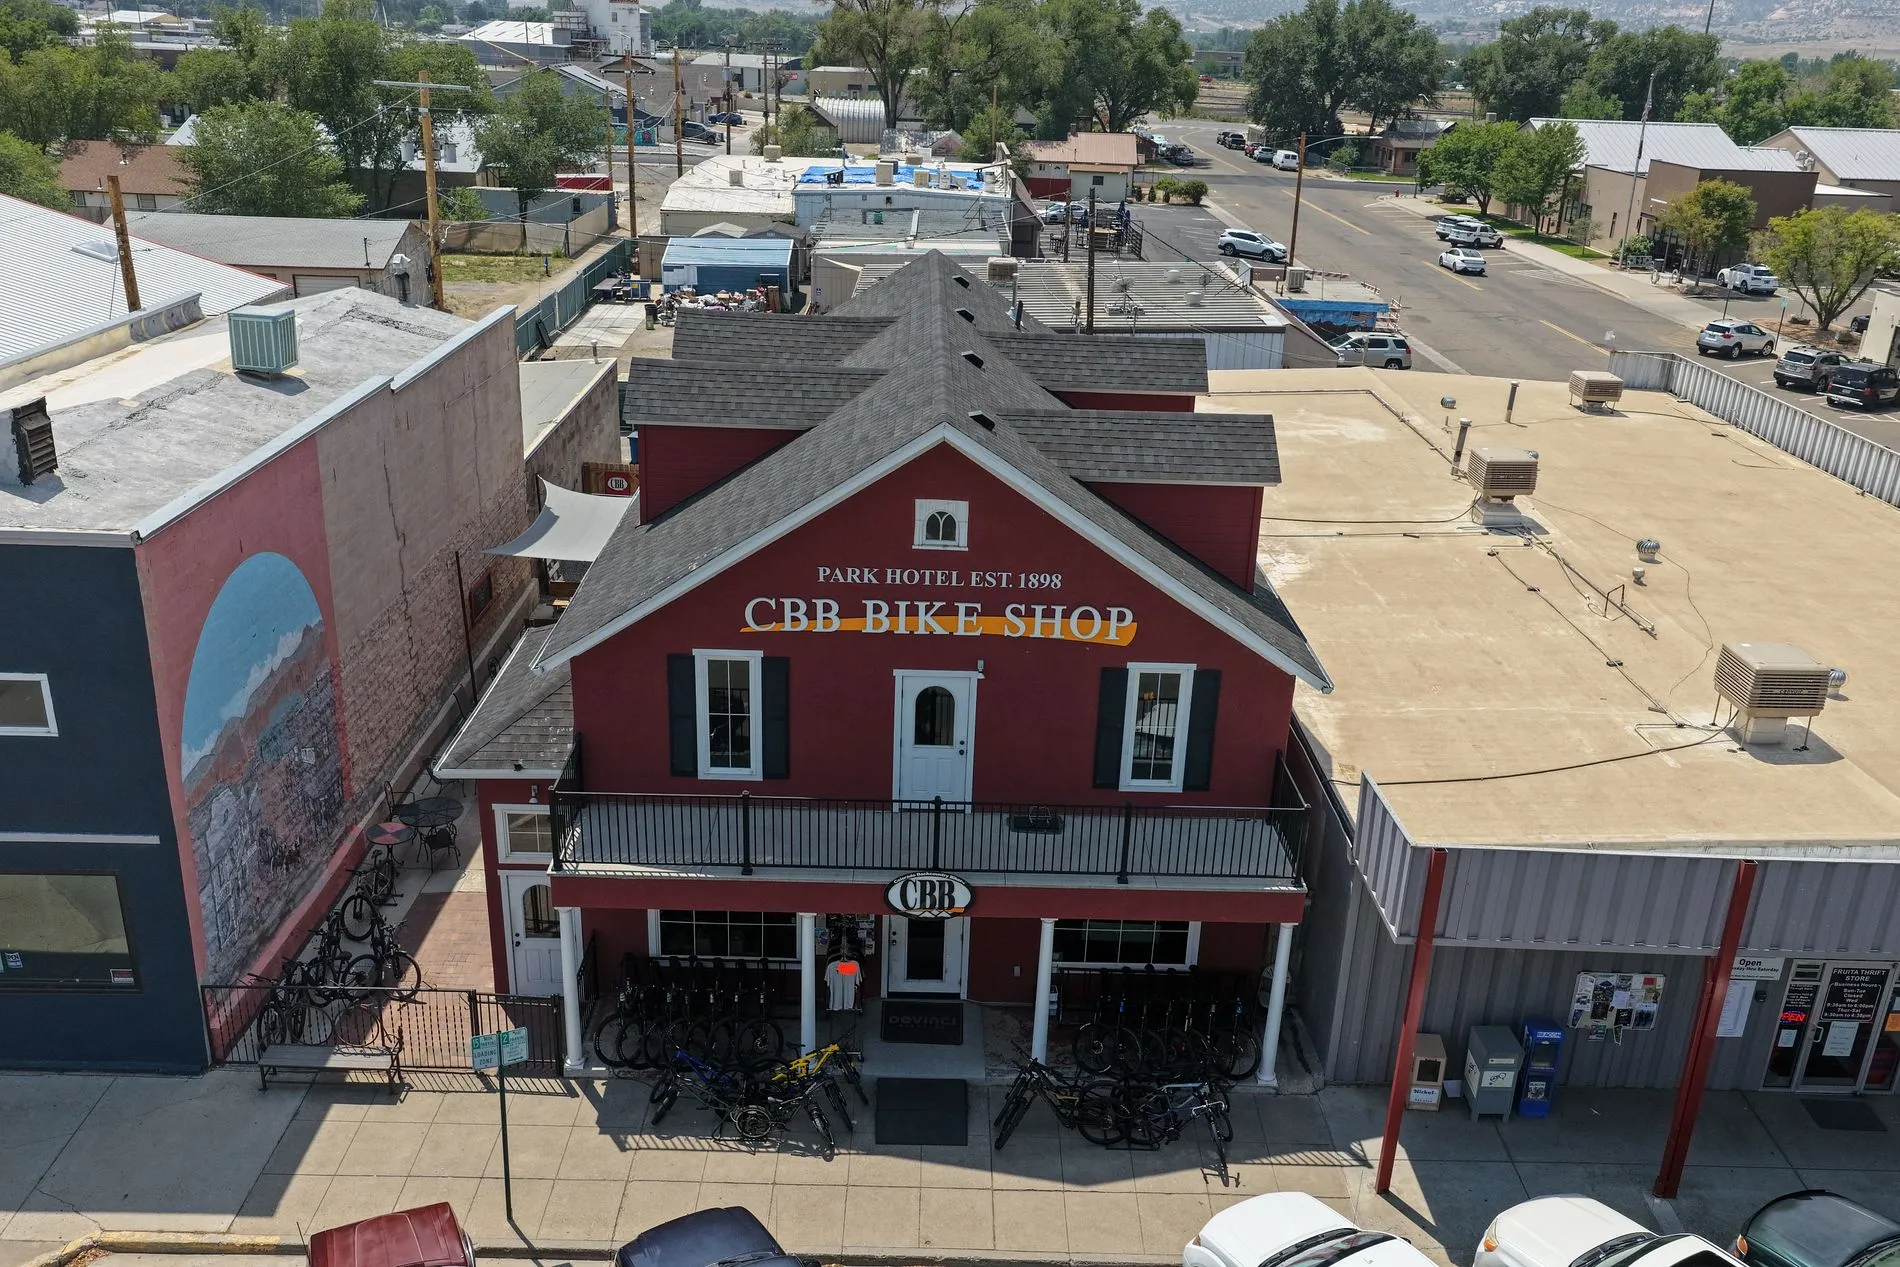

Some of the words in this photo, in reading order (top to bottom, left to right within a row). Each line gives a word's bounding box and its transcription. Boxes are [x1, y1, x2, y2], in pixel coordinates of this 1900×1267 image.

[610, 479, 624, 488] CBB
[817, 566, 880, 584] PARK
[884, 568, 965, 587] HOTEL
[969, 571, 1013, 588] EST.
[1018, 572, 1063, 590] 1898
[744, 597, 841, 633] CBB
[861, 599, 984, 637] BIKE
[1003, 603, 1135, 642] SHOP
[900, 879, 956, 910] CBB
[1739, 958, 1762, 967] Open
[472, 1037, 480, 1049] 15
[502, 1033, 509, 1045] 2
[474, 1050, 497, 1058] LOADING
